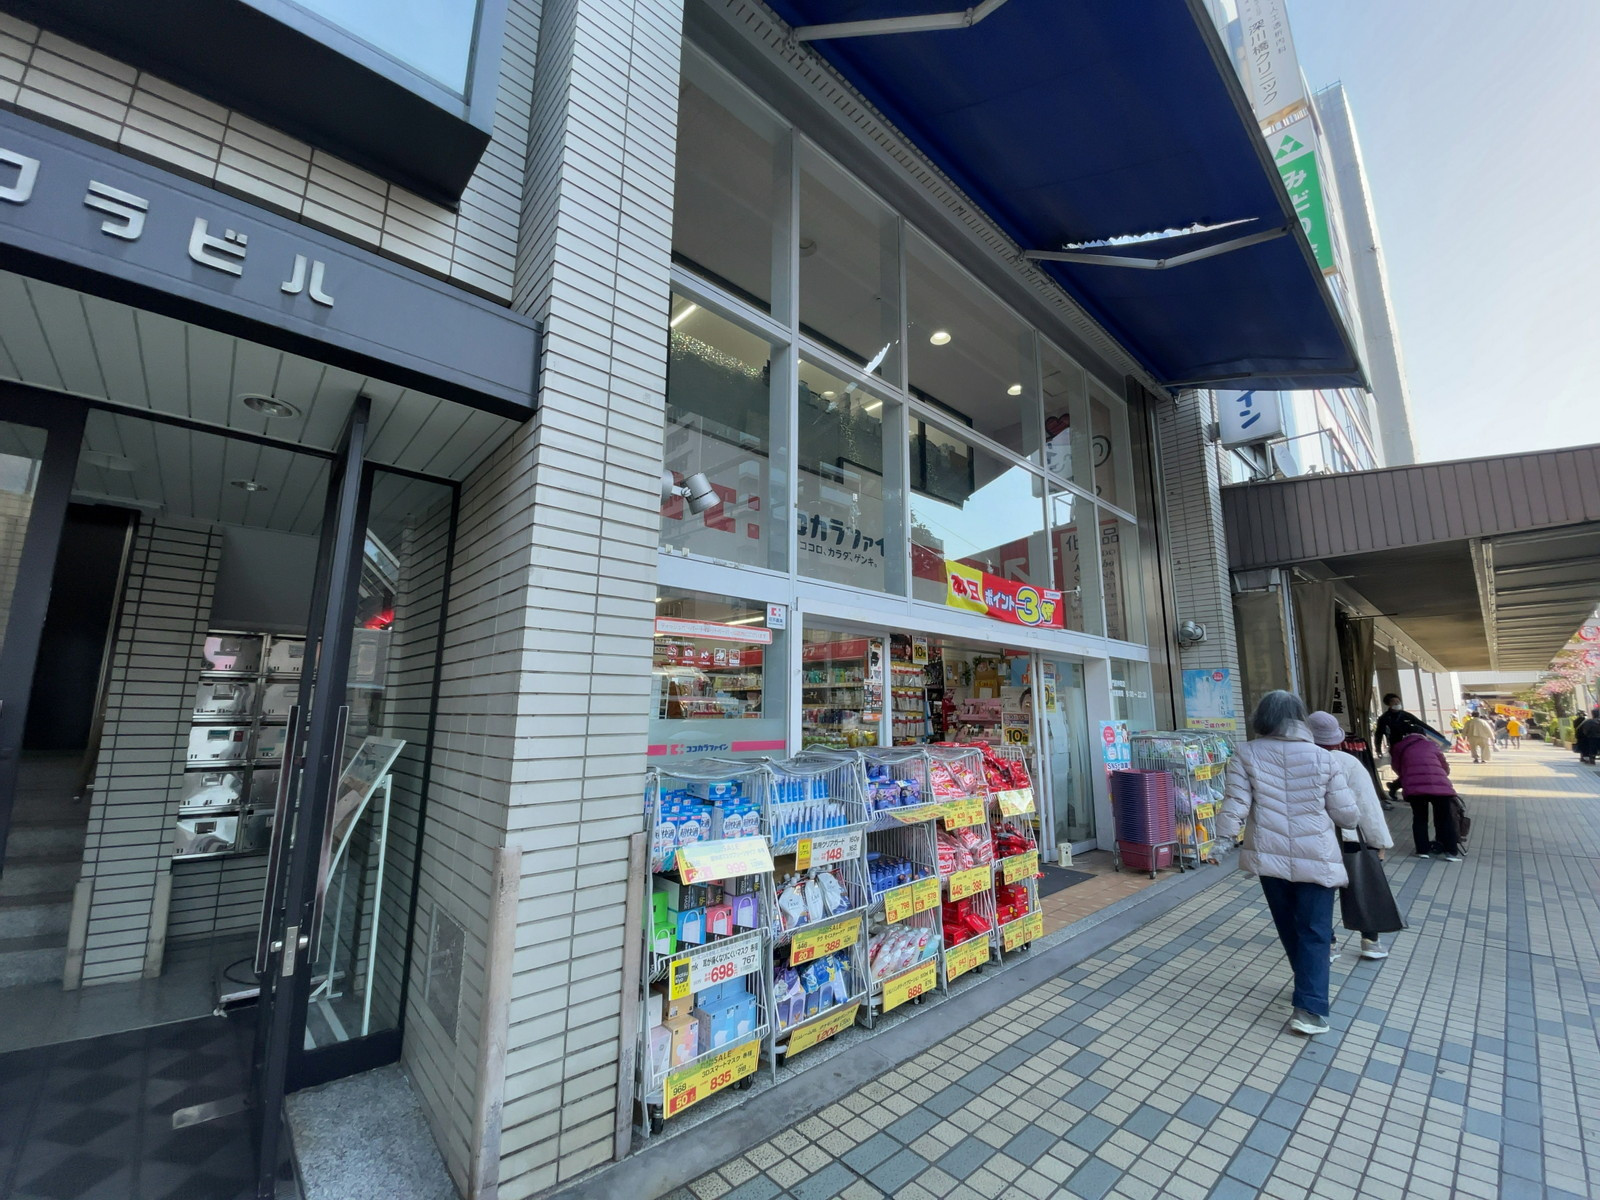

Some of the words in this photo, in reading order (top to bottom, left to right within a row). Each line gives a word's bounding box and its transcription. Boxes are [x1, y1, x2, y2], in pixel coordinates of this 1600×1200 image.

[686, 744, 729, 753] ココカラファイン
[826, 847, 842, 861] 148
[824, 939, 841, 953] 388
[710, 961, 734, 983] 698
[742, 954, 756, 965] 767
[907, 983, 922, 999] 888
[702, 1055, 741, 1078] 3Dスマートマスク
[673, 1083, 687, 1096] 968
[709, 1069, 732, 1090] 835
[676, 1094, 688, 1109] 50
